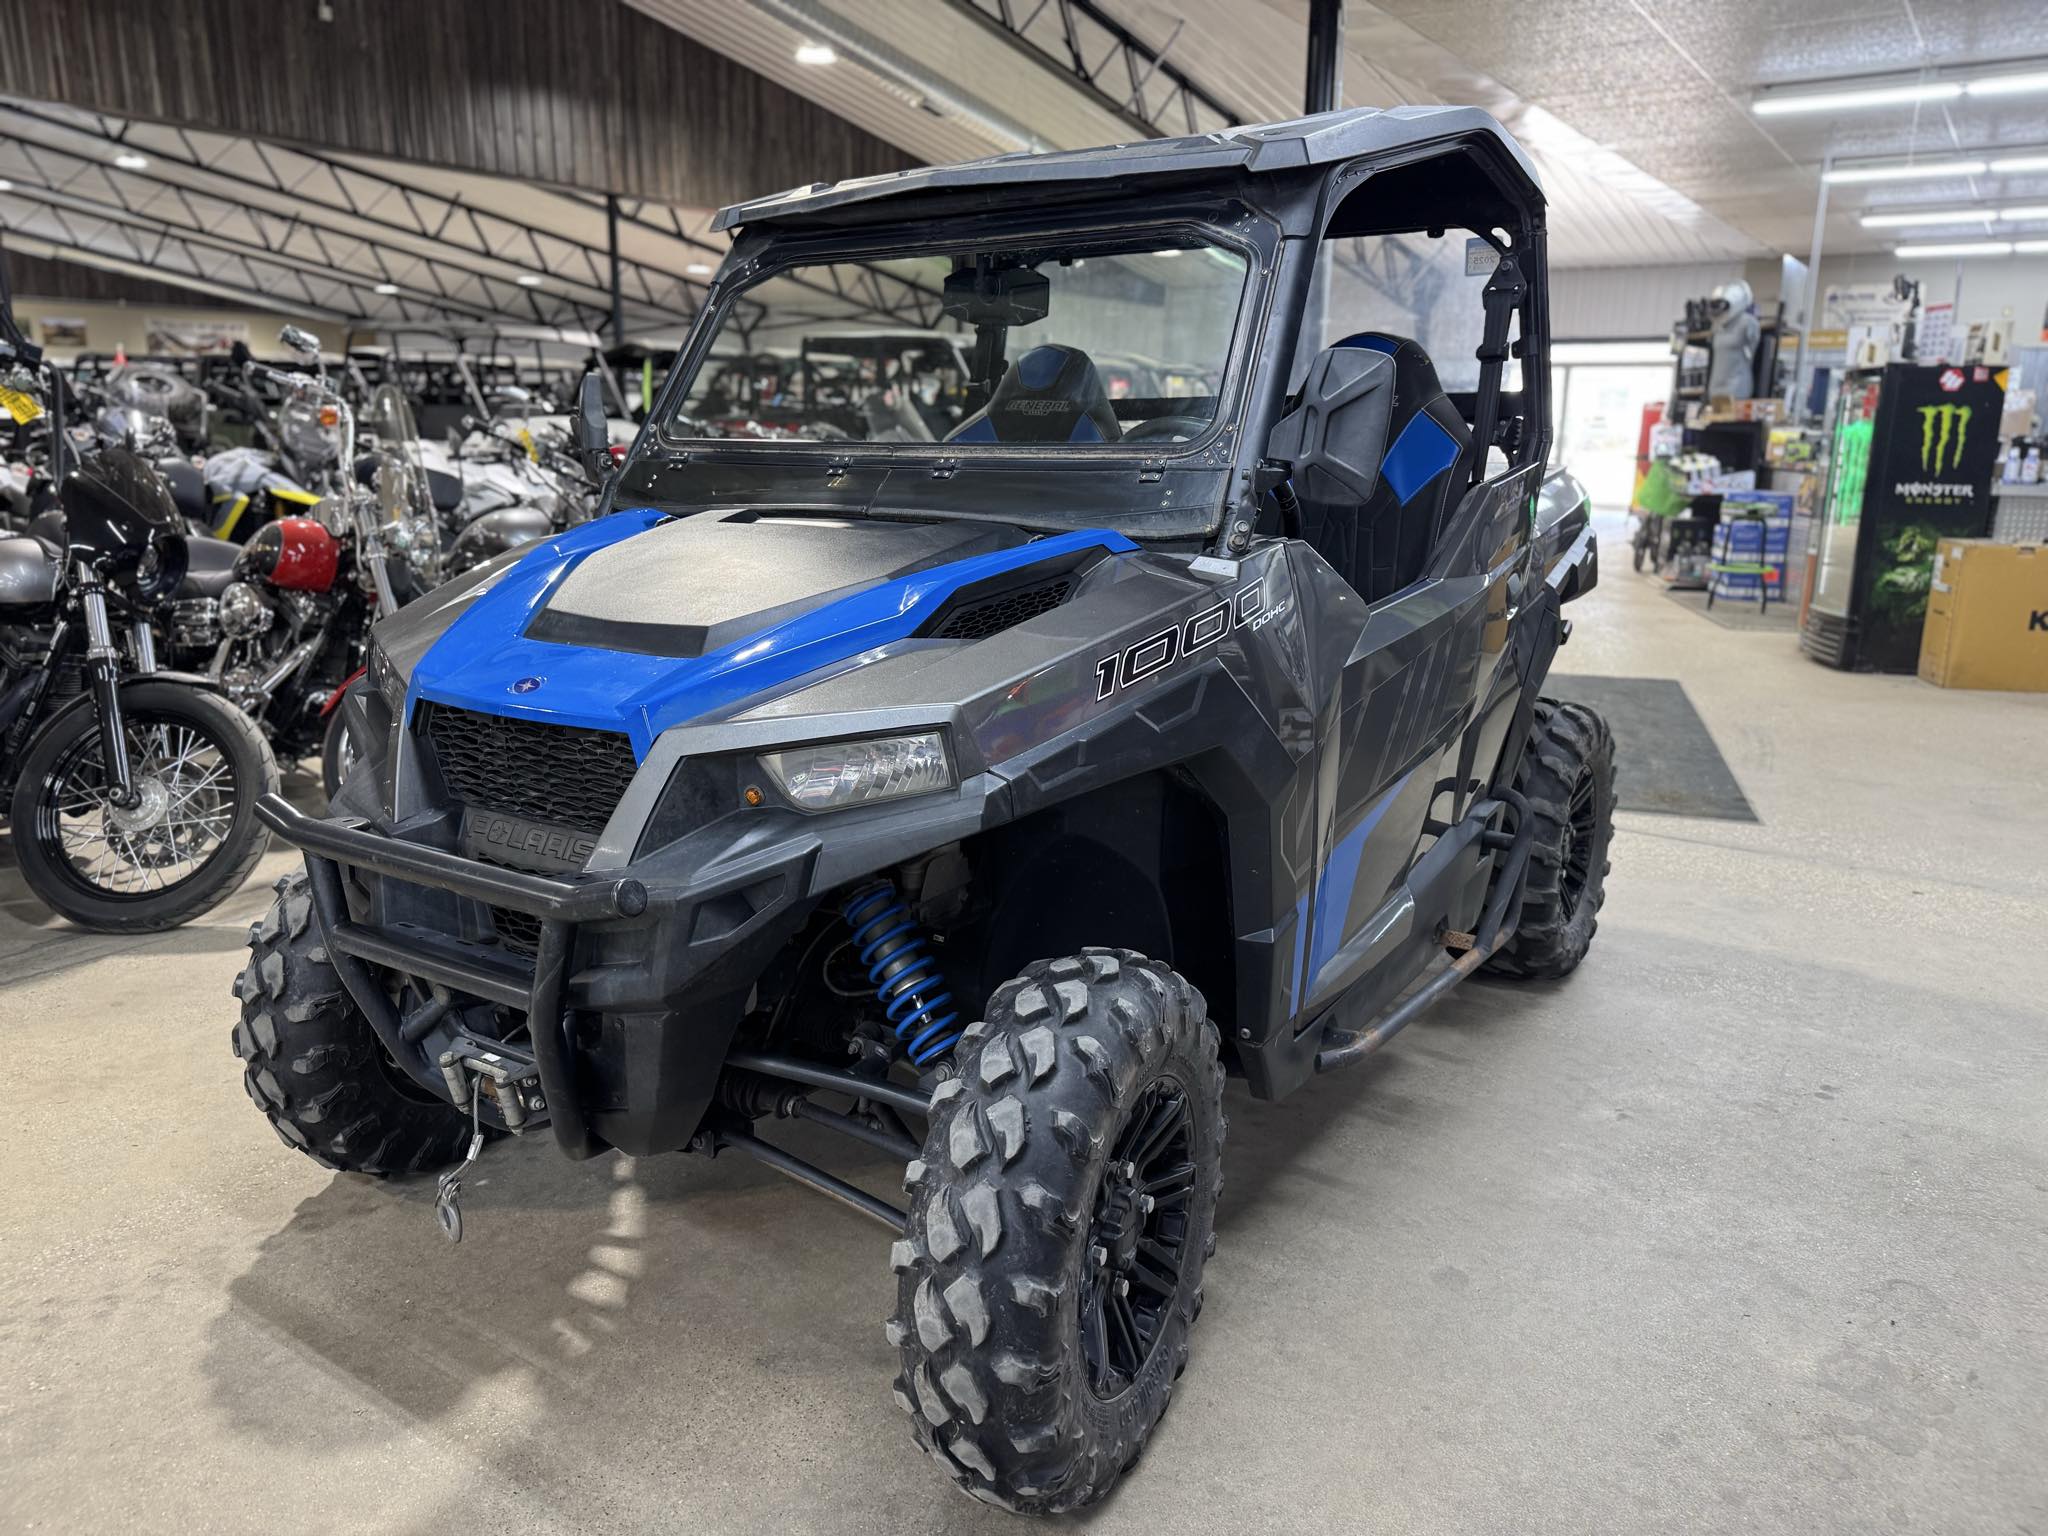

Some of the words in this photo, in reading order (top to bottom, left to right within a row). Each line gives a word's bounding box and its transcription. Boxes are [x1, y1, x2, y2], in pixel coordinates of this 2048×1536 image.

[1894, 481, 1975, 498] MONSTER
[1252, 600, 1286, 632] DOHC
[1095, 576, 1267, 703] 1000
[468, 814, 597, 865] POLARIS
